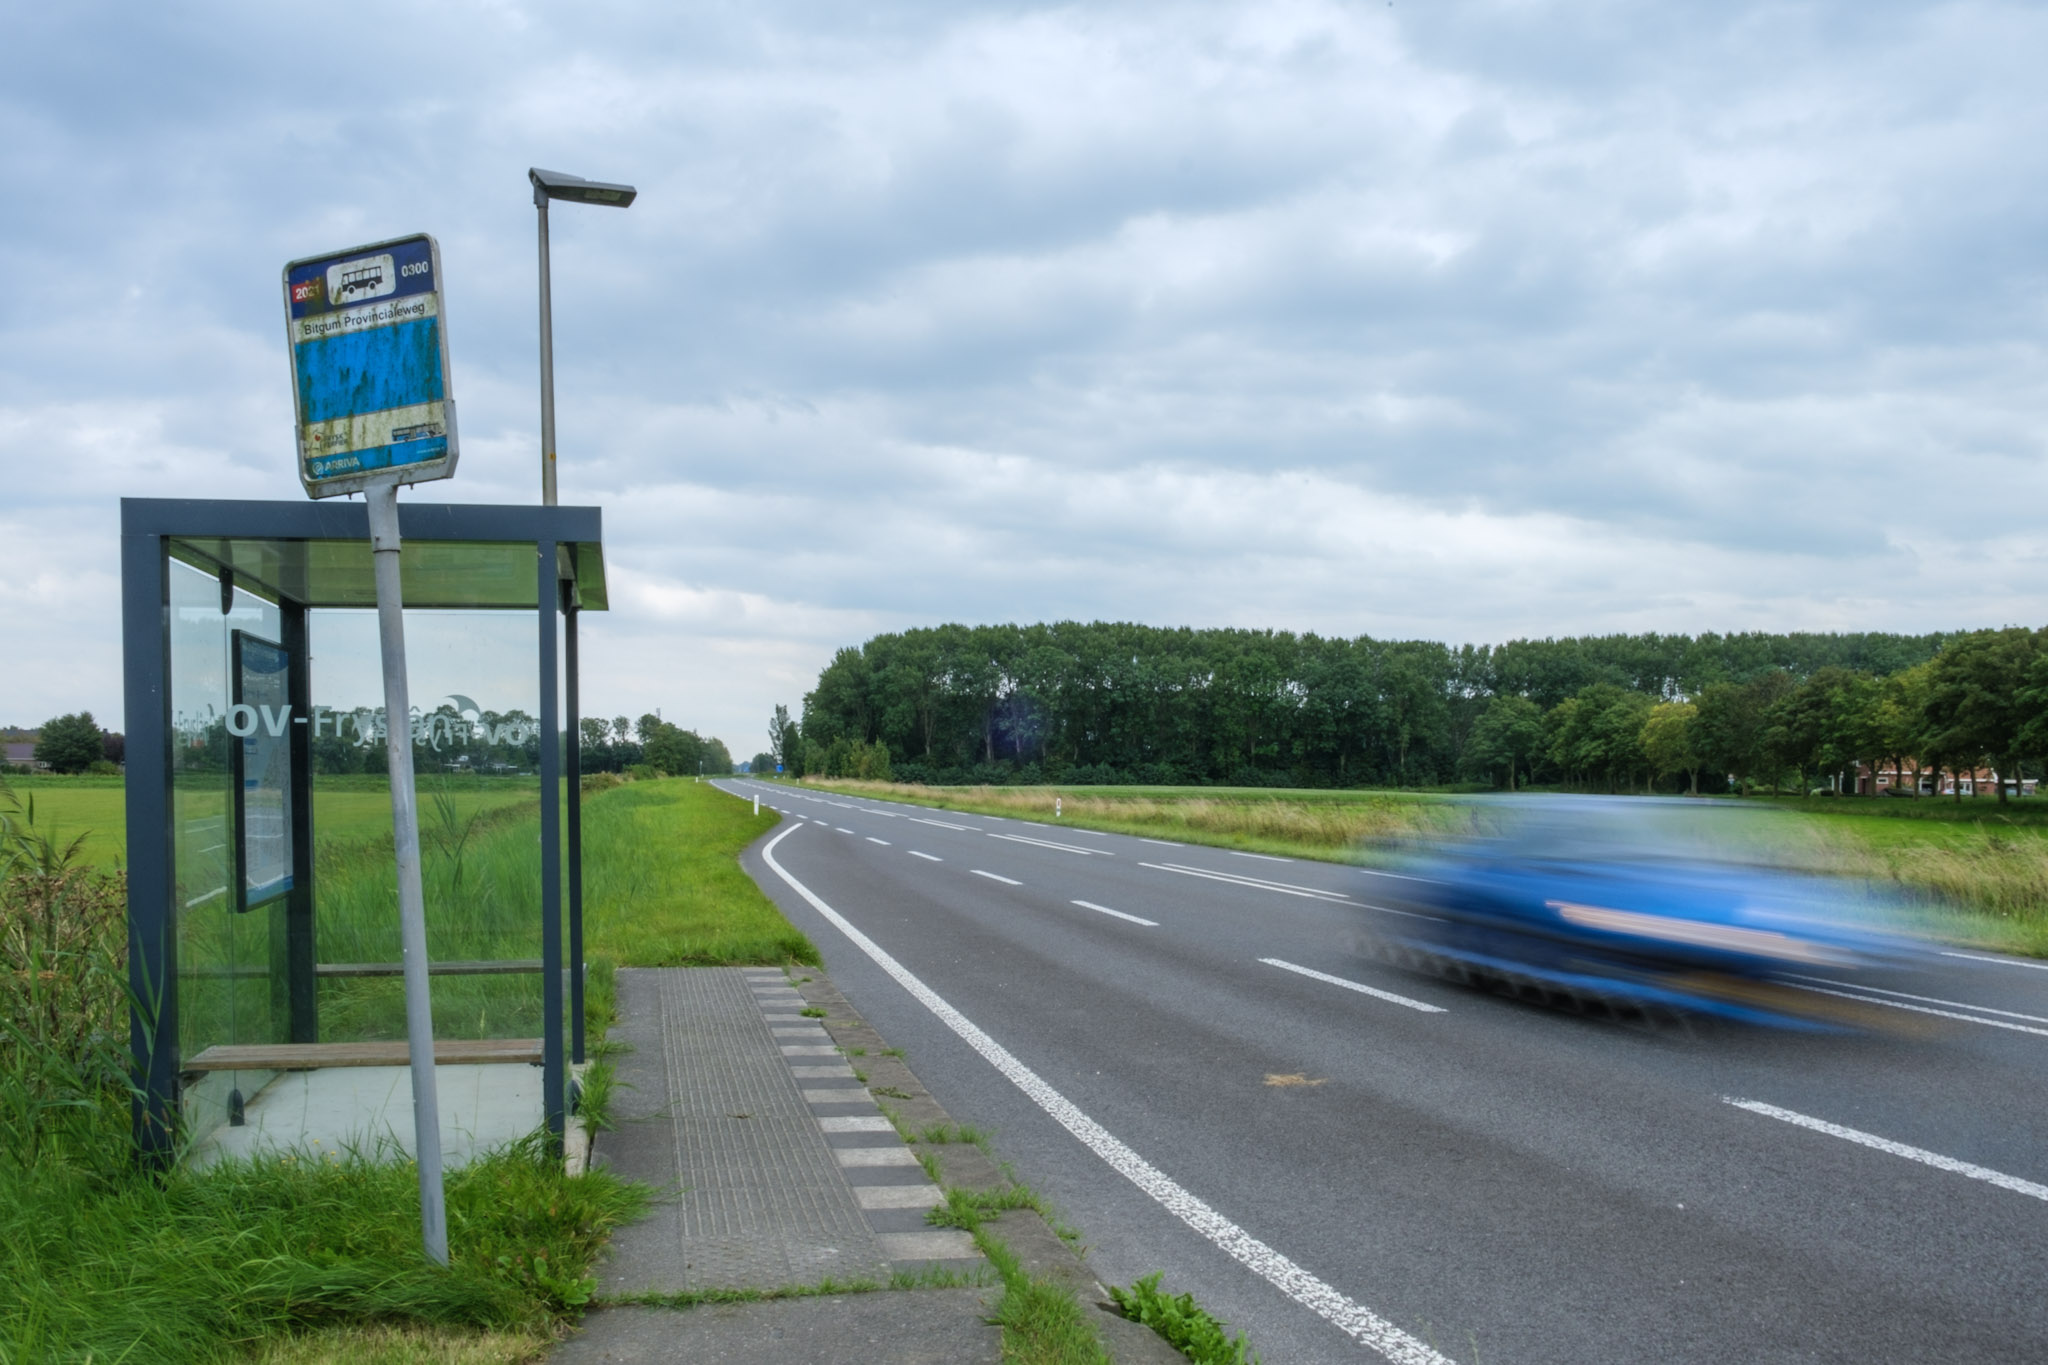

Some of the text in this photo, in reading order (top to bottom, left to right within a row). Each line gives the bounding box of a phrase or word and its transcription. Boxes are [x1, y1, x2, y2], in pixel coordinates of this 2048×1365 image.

[401, 261, 429, 277] 0300
[295, 284, 321, 300] 2021
[304, 303, 425, 335] Bitgum Provincialeweg
[324, 457, 360, 471] ARRIVA
[225, 704, 451, 747] OV-Frysân
